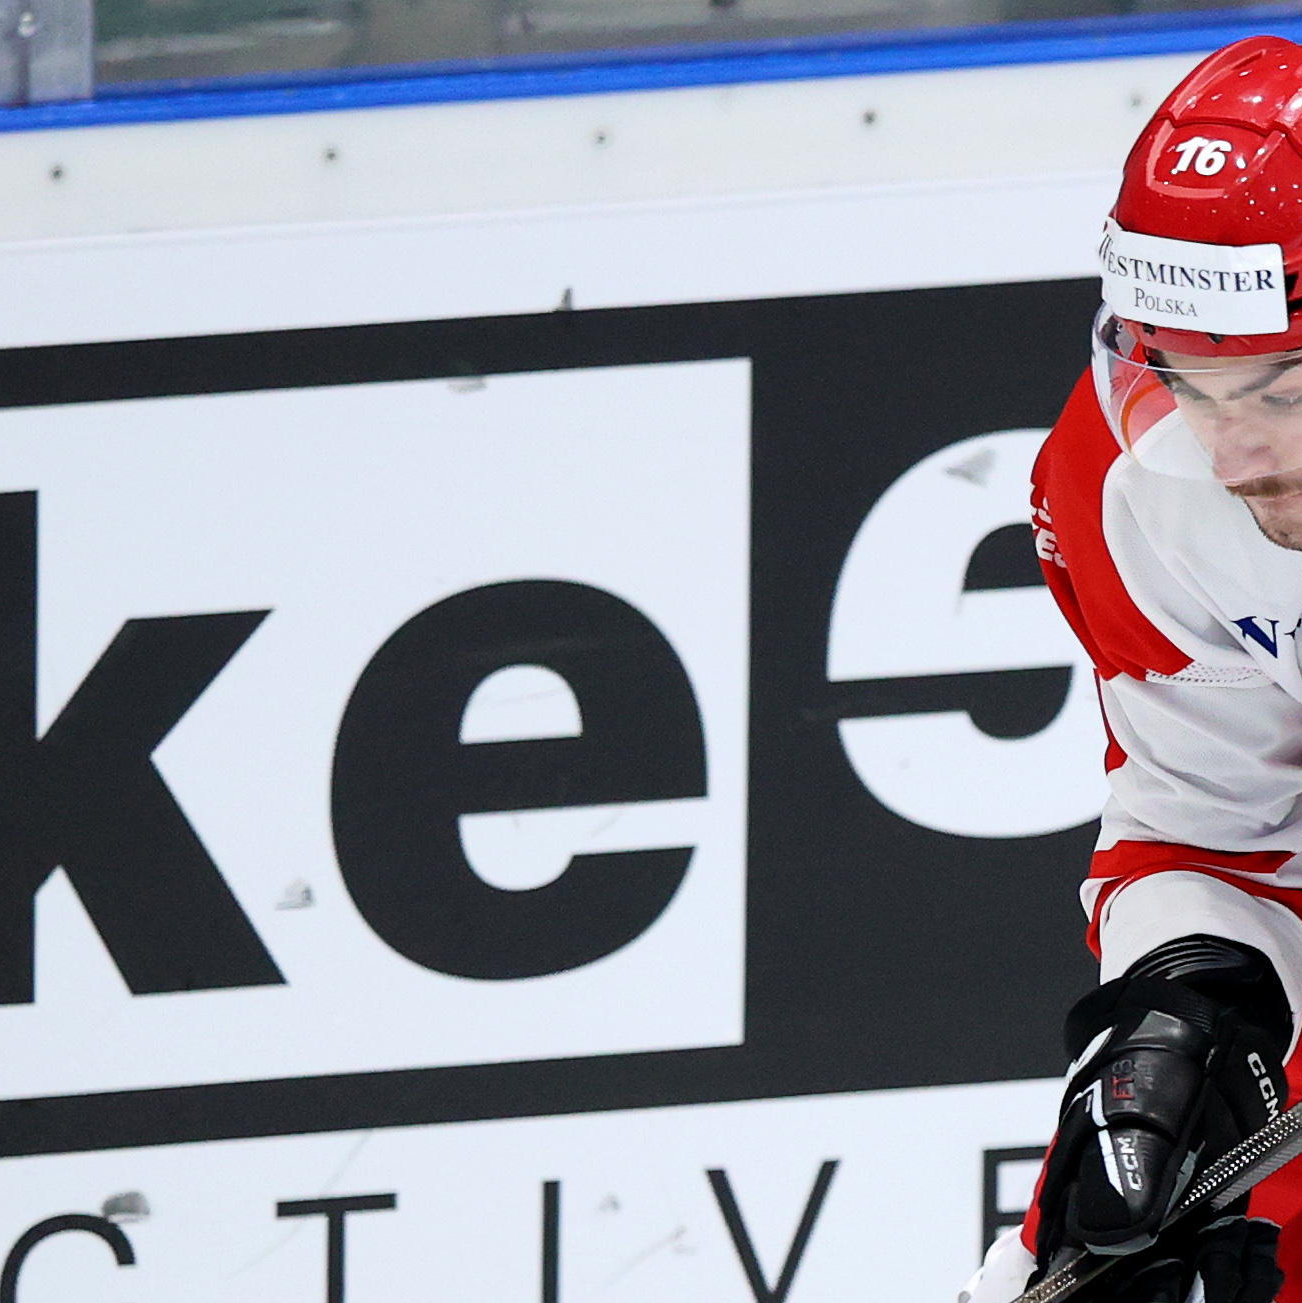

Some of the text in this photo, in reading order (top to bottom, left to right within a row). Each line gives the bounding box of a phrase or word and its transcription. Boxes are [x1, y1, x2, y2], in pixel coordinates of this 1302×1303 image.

[1174, 136, 1232, 176] 16
[1247, 1051, 1281, 1122] CCM
[1116, 1136, 1144, 1192] CCM
